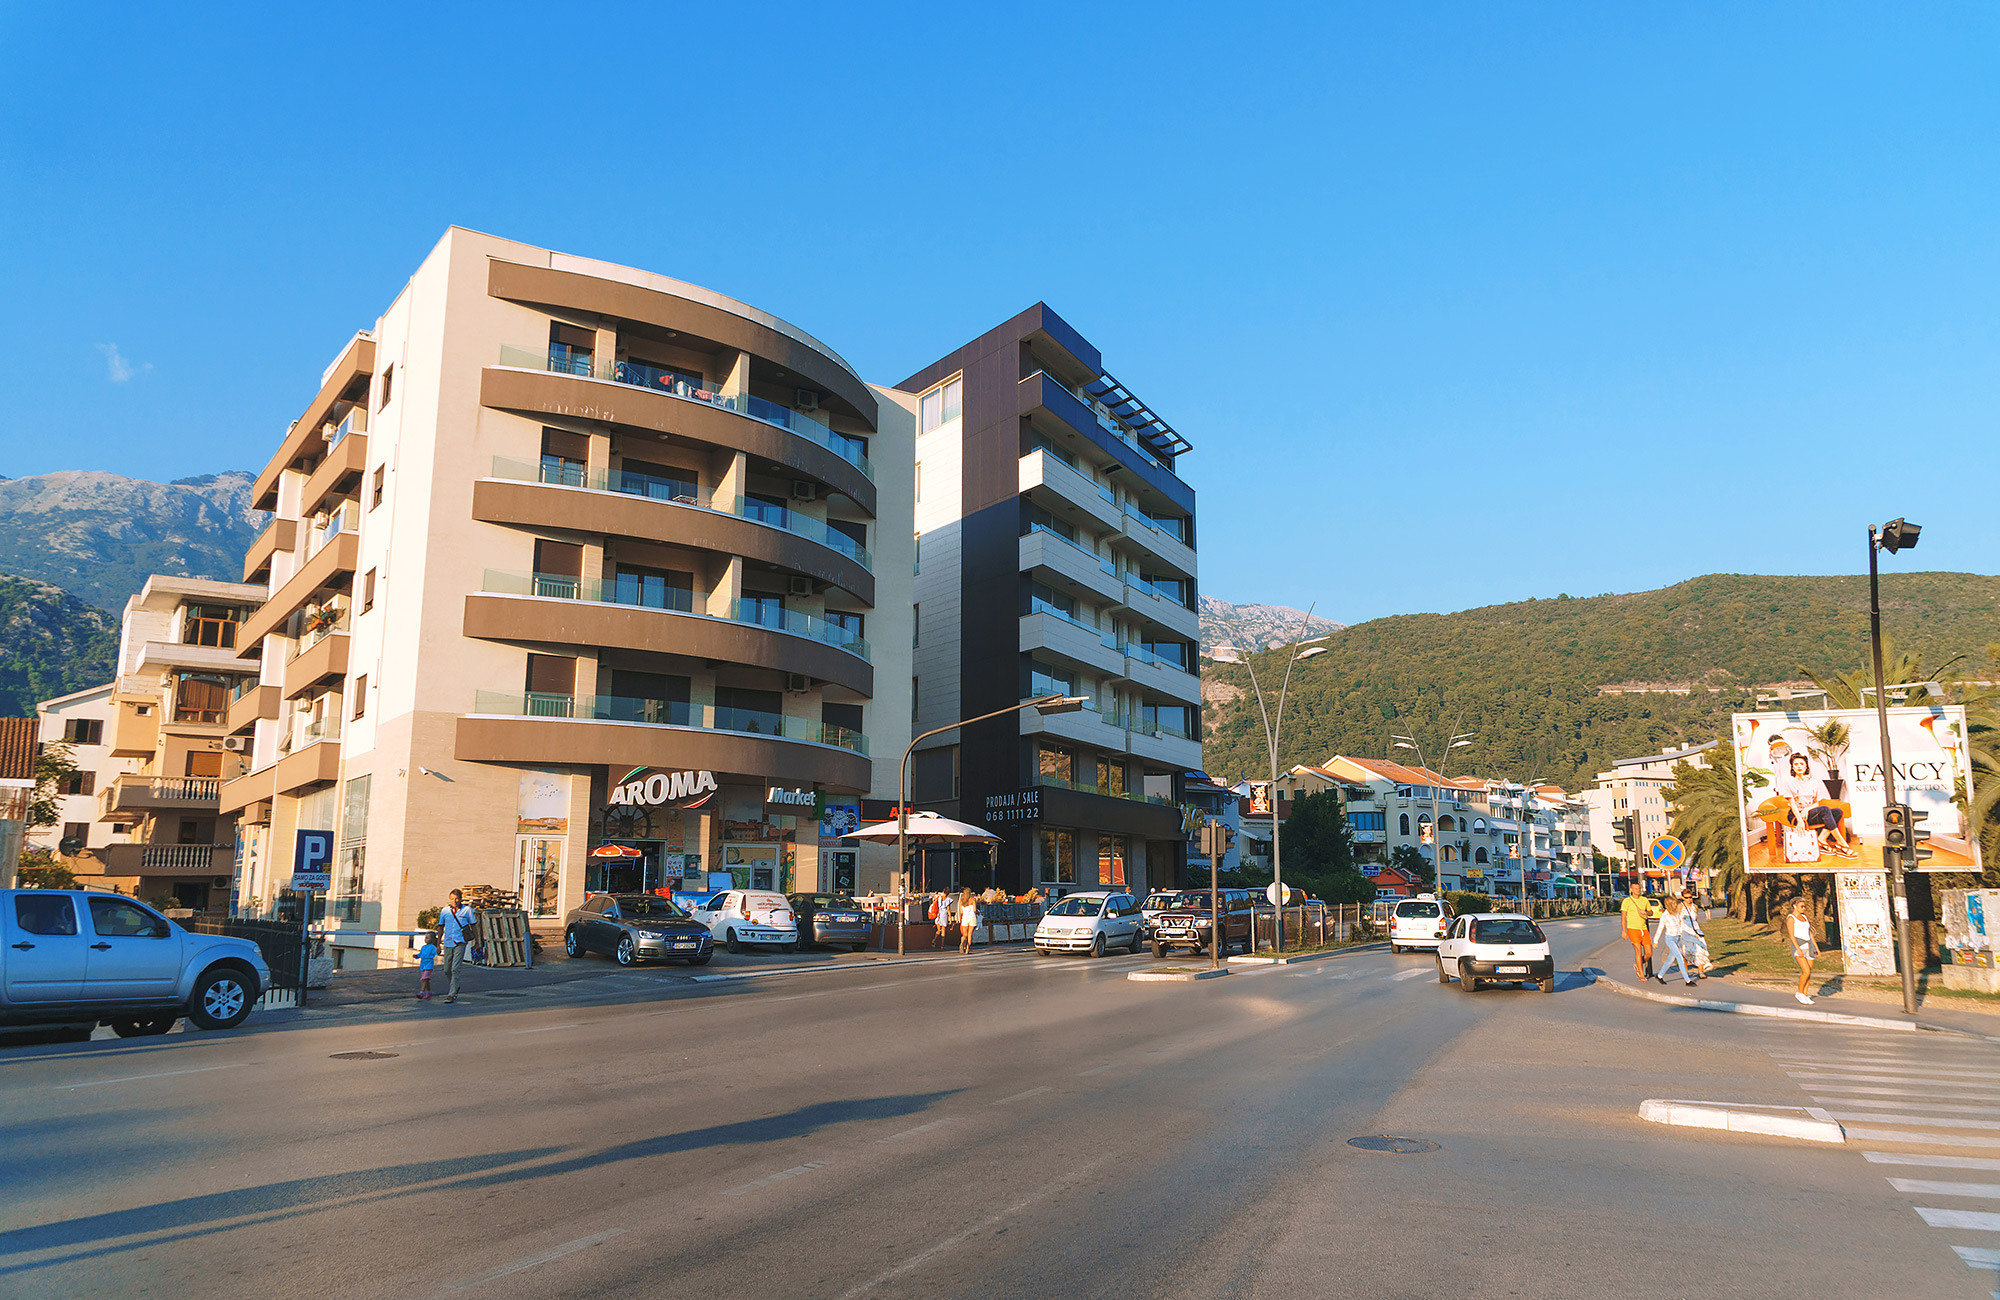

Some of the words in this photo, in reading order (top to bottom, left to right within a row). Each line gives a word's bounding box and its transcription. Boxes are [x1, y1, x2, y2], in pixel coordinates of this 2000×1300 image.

[1854, 762, 1946, 782] FANCY
[608, 770, 718, 805] AROMA
[767, 786, 817, 807] Market
[1855, 785, 1879, 793] NEW
[986, 793, 1015, 808] PRODAJA
[1022, 790, 1039, 804] SALE
[985, 810, 1004, 822] 068
[1026, 807, 1039, 819] 22
[302, 835, 326, 870] P
